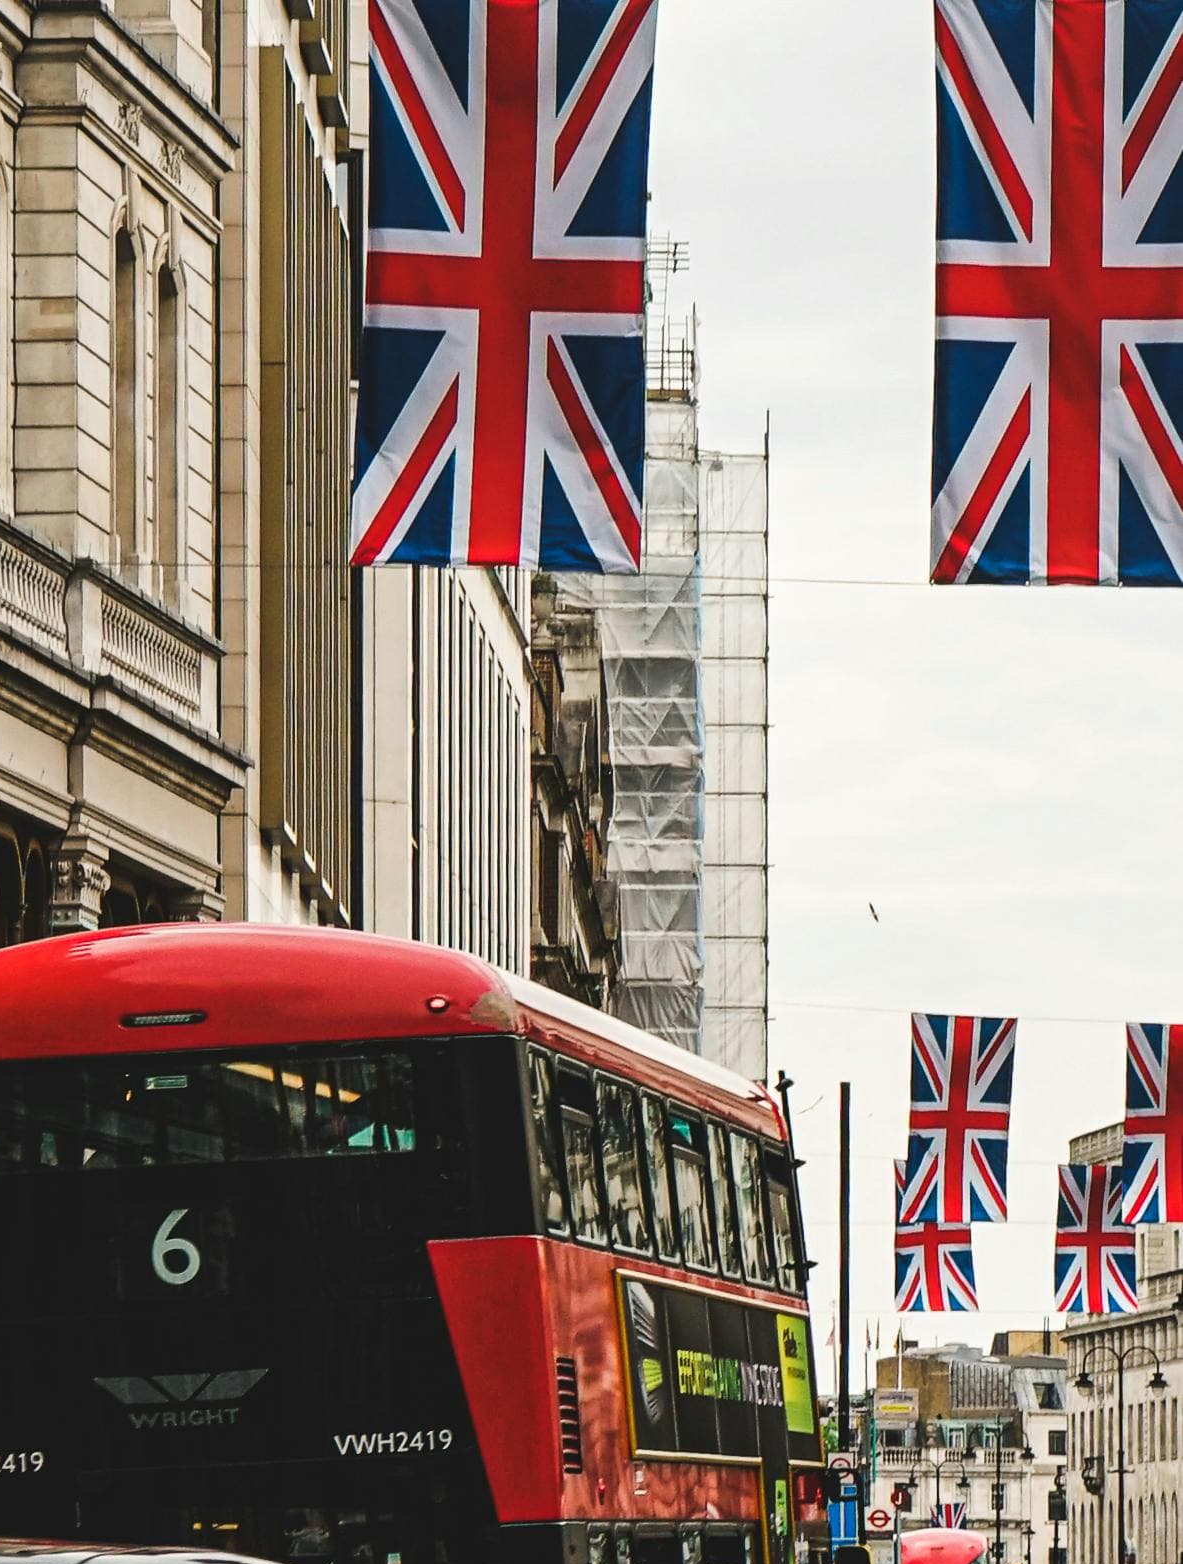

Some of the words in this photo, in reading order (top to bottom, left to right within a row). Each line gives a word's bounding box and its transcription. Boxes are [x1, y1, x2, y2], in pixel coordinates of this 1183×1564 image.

[152, 1208, 200, 1285] 6
[129, 1406, 240, 1429] WRIGHT
[332, 1428, 453, 1456] VWH2419
